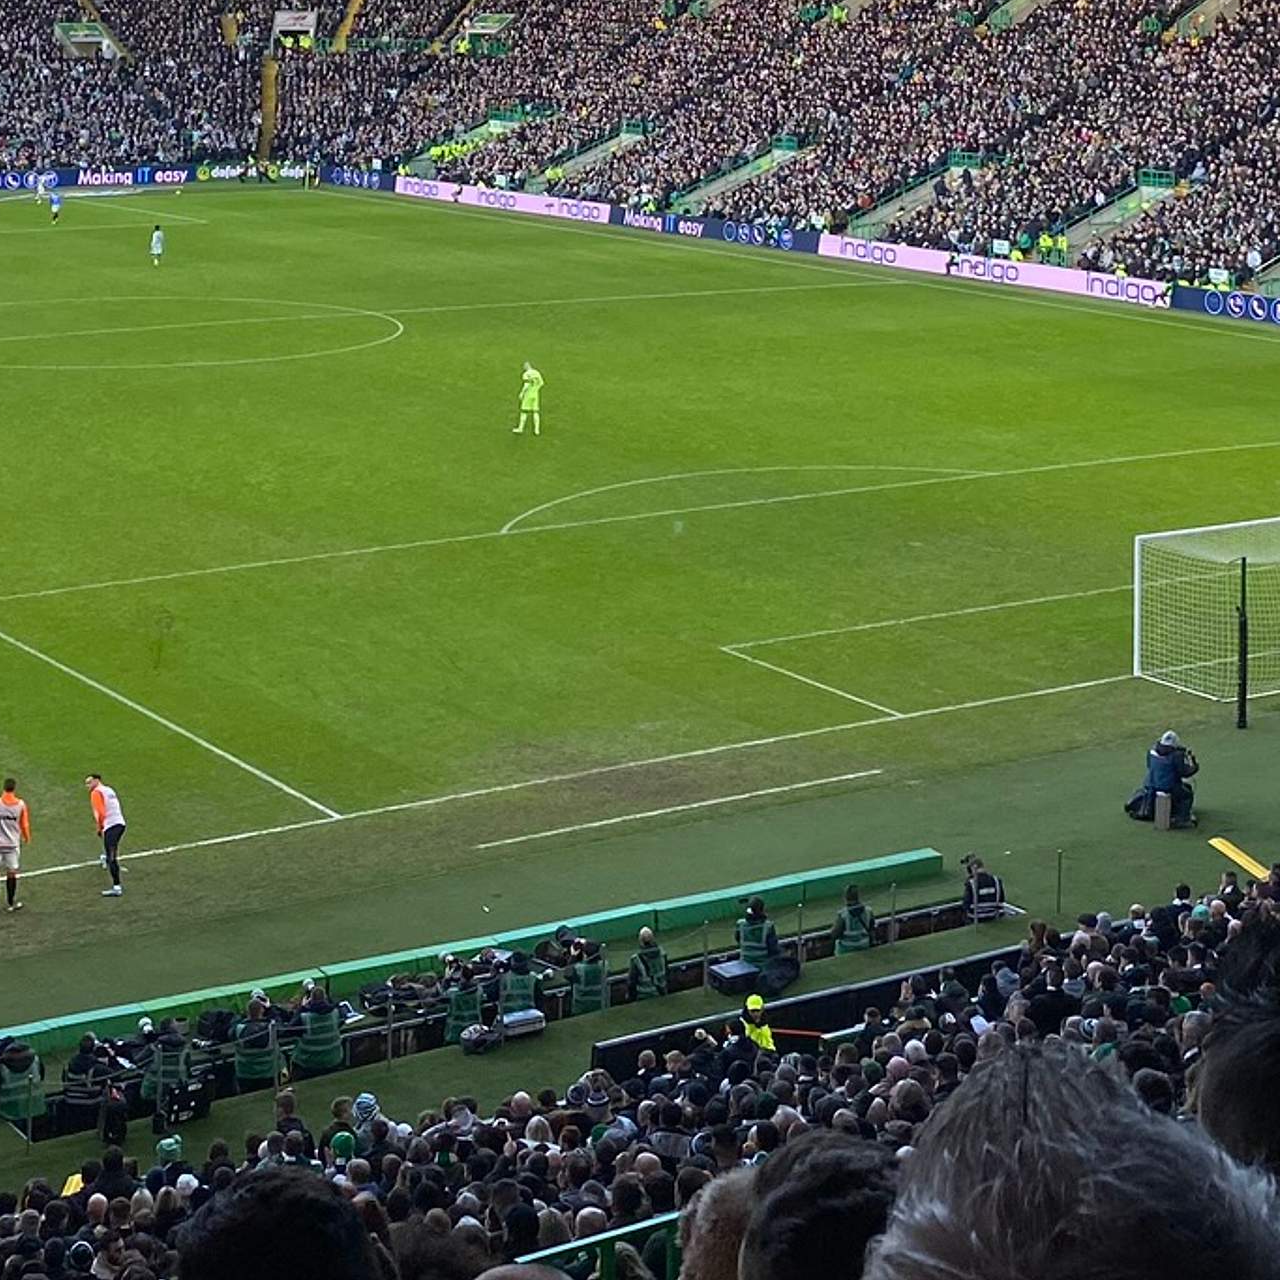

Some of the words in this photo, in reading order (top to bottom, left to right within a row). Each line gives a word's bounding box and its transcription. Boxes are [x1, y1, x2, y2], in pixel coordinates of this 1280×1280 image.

[78, 168, 133, 186] Making
[136, 166, 152, 182] IT
[155, 167, 189, 184] easy
[402, 177, 439, 197] indigo
[477, 186, 517, 209] indigo
[558, 197, 601, 220] indigo
[623, 208, 662, 232] Making
[665, 213, 676, 234] IT
[677, 219, 705, 239] easy
[839, 235, 897, 265] indigo
[1086, 271, 1158, 304] indigo
